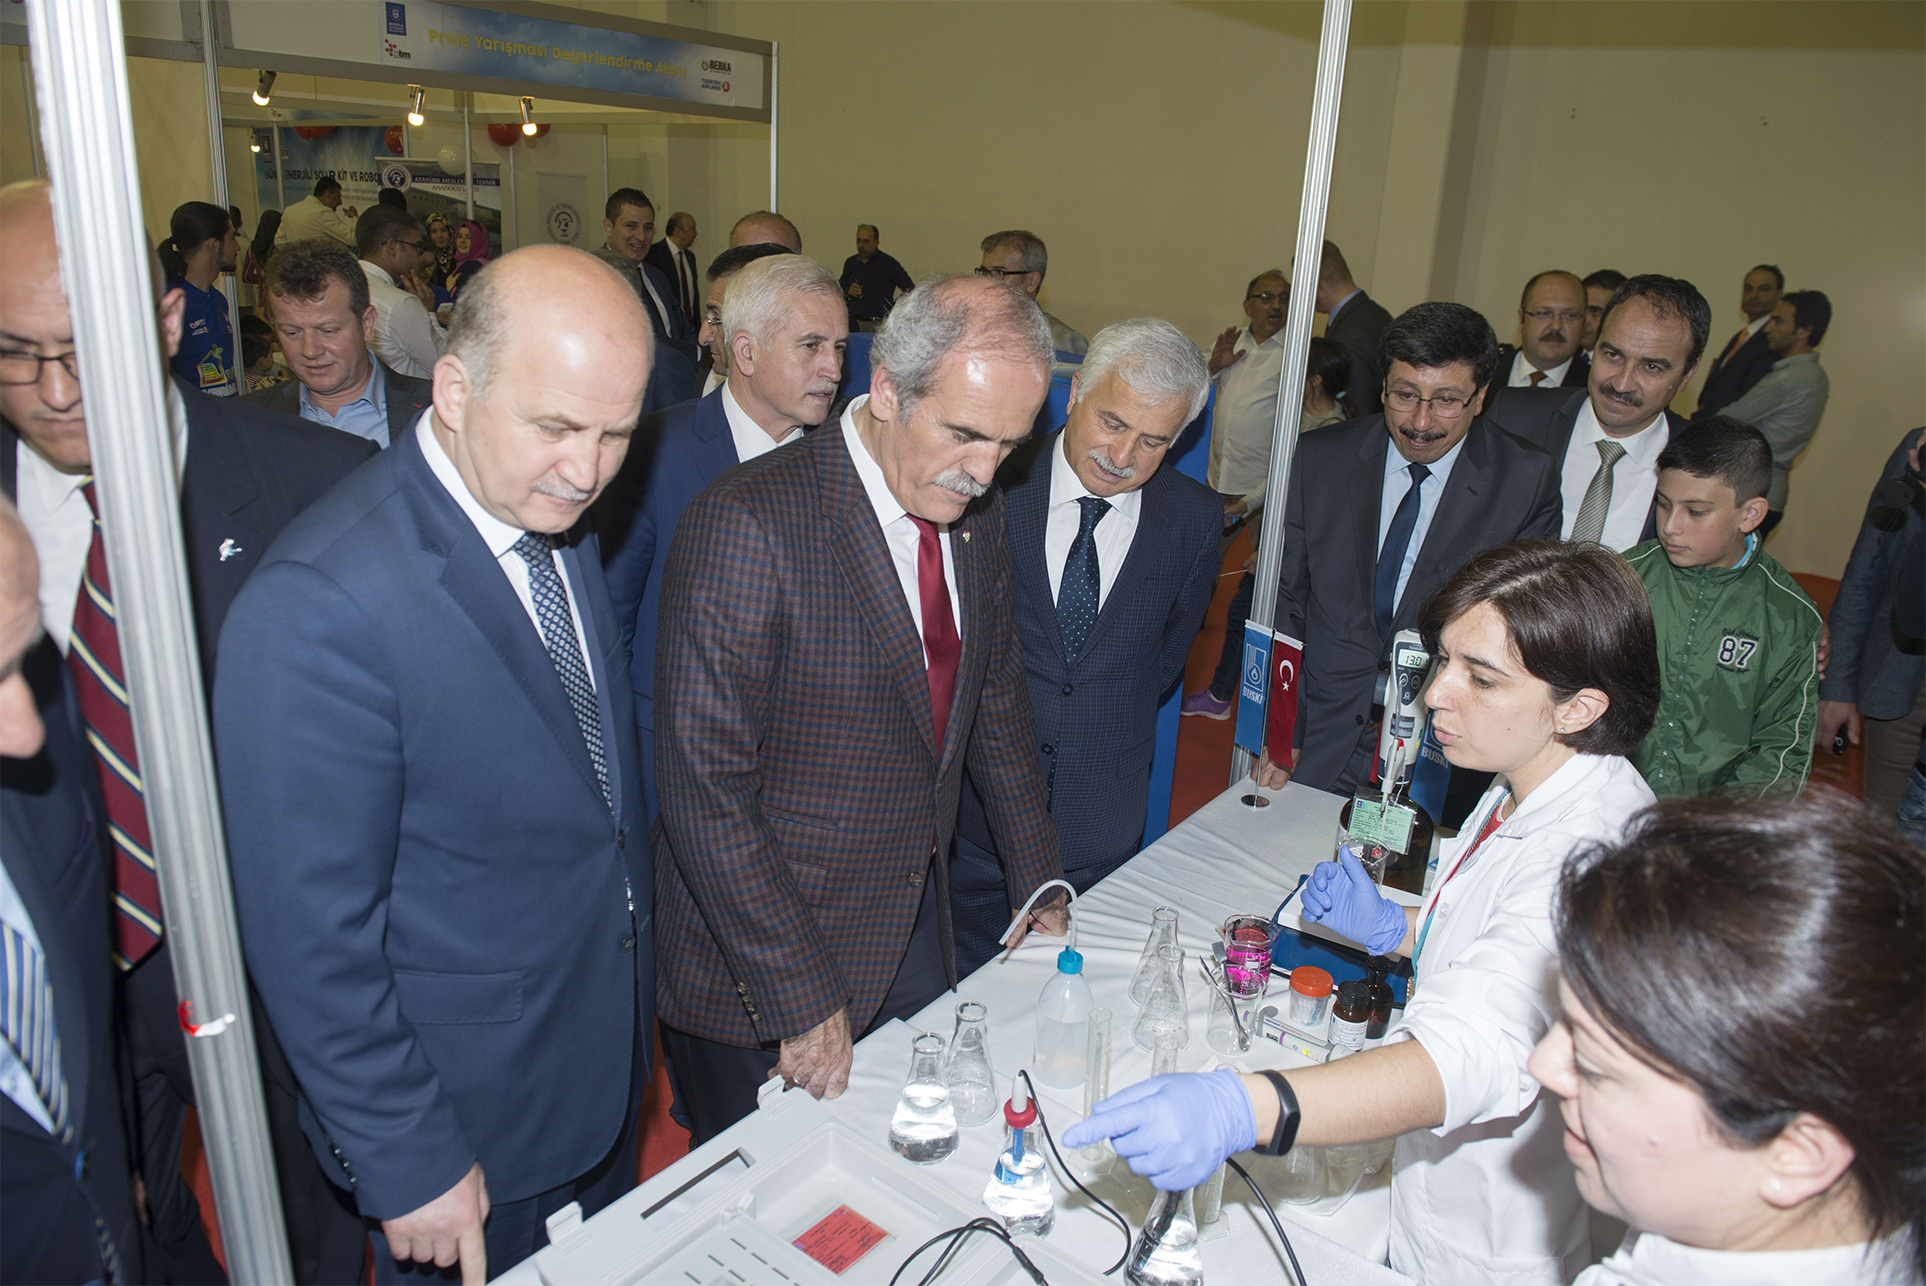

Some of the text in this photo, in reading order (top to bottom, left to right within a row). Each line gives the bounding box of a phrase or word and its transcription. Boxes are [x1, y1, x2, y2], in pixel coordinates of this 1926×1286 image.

[428, 28, 687, 77] Proje Yarışması Değerlendirme Alanı
[709, 59, 732, 72] BEBKA
[701, 77, 721, 85] TURKISH
[264, 167, 284, 180] GÜN
[349, 170, 358, 182] VE
[359, 171, 378, 183] ROBO
[1718, 635, 1758, 668] 87
